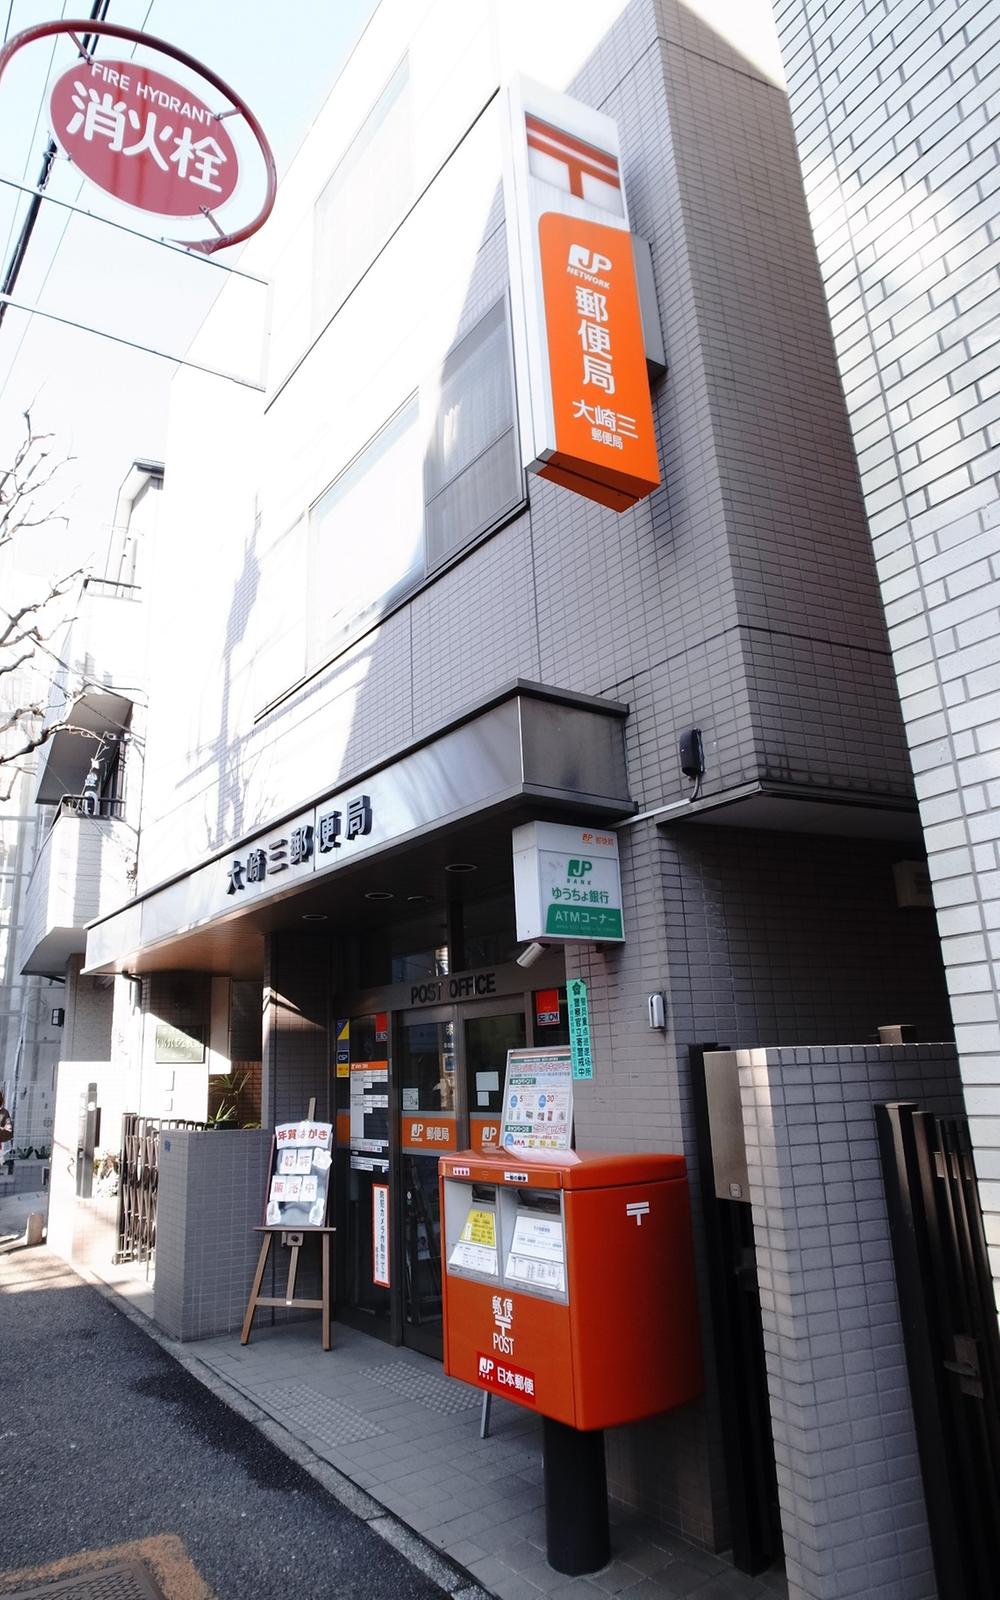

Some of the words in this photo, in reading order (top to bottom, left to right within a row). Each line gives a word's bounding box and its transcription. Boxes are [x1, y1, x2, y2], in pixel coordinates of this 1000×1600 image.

[91, 61, 130, 91] FIRE
[136, 82, 216, 127] HYDRANT
[66, 80, 228, 193] 消火栓
[568, 243, 612, 275] JP
[567, 265, 611, 290] NETWORK
[575, 285, 616, 395] 郵便局
[572, 399, 639, 439] 大崎三
[591, 428, 624, 450] 郵便局
[226, 795, 373, 895] 大崎三郵便局
[567, 859, 592, 877] JP
[552, 887, 609, 904] ゆうちょ銀行
[555, 911, 616, 924] ATMコーナー
[411, 982, 443, 1005] POST
[449, 973, 496, 998] OFFICE
[278, 1128, 328, 1141] 年賀はがき
[426, 1126, 449, 1142] 郵便局
[492, 1295, 513, 1320] 郵便
[493, 1332, 514, 1355] POST
[497, 1366, 535, 1396] 日本郵便
